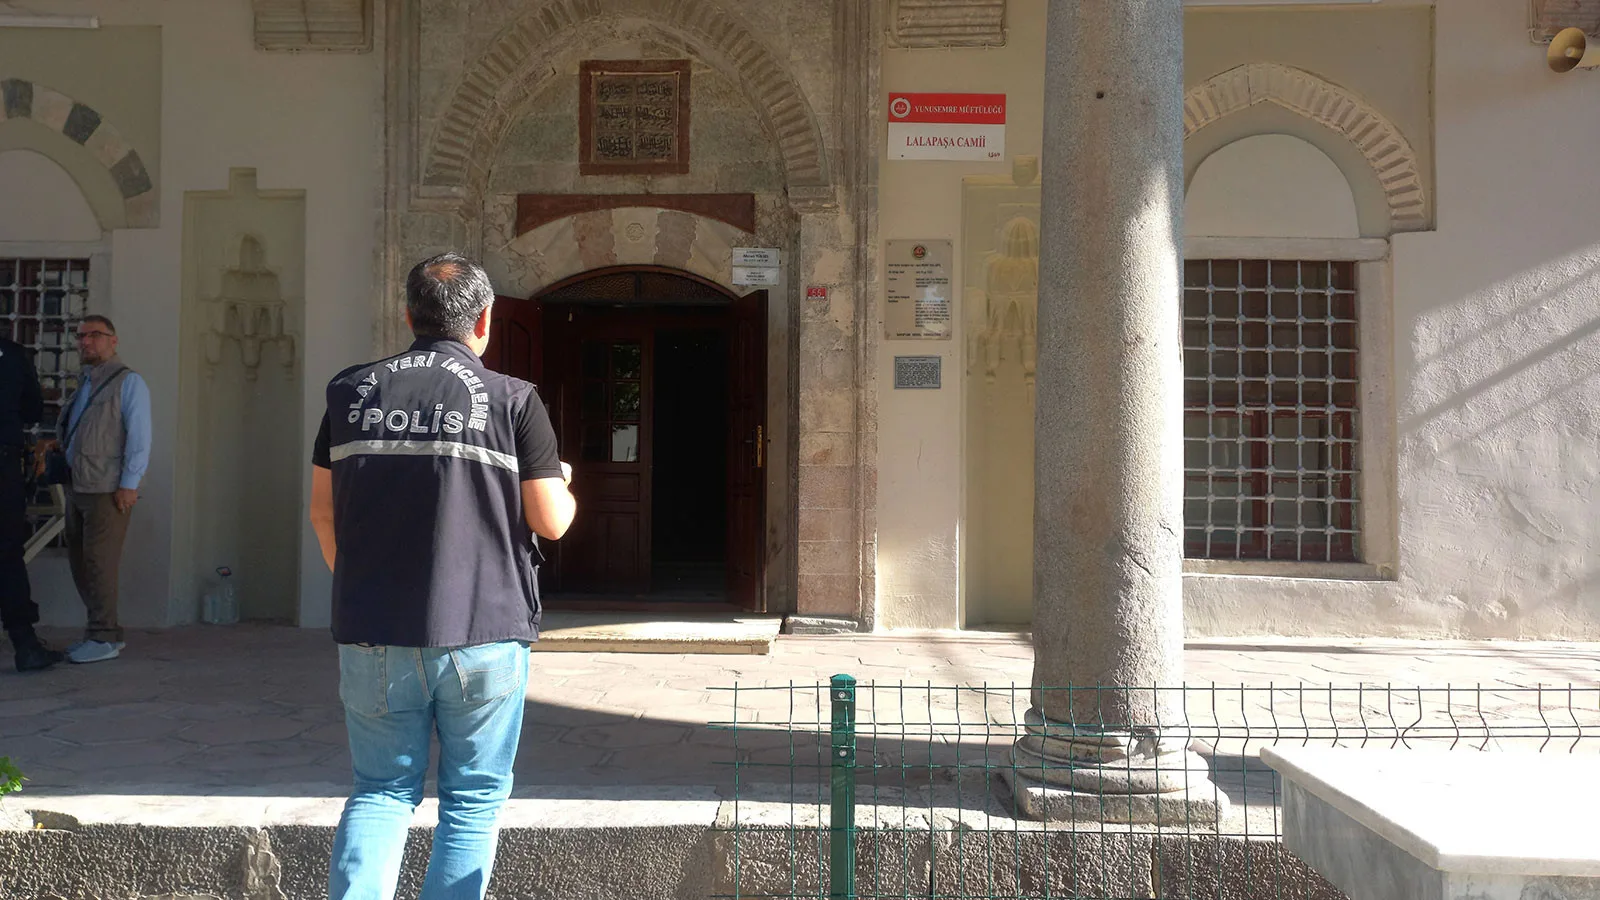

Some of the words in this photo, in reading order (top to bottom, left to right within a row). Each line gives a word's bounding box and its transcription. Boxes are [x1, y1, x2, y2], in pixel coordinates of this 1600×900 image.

[914, 105, 958, 114] YUNUSEMRE
[959, 104, 1003, 114] MÜFTÜLÜĞÜ
[906, 136, 955, 149] LALAPAŞA
[957, 135, 986, 148] CAMİİ
[347, 372, 378, 423] OLAY
[361, 403, 464, 433] POLİS
